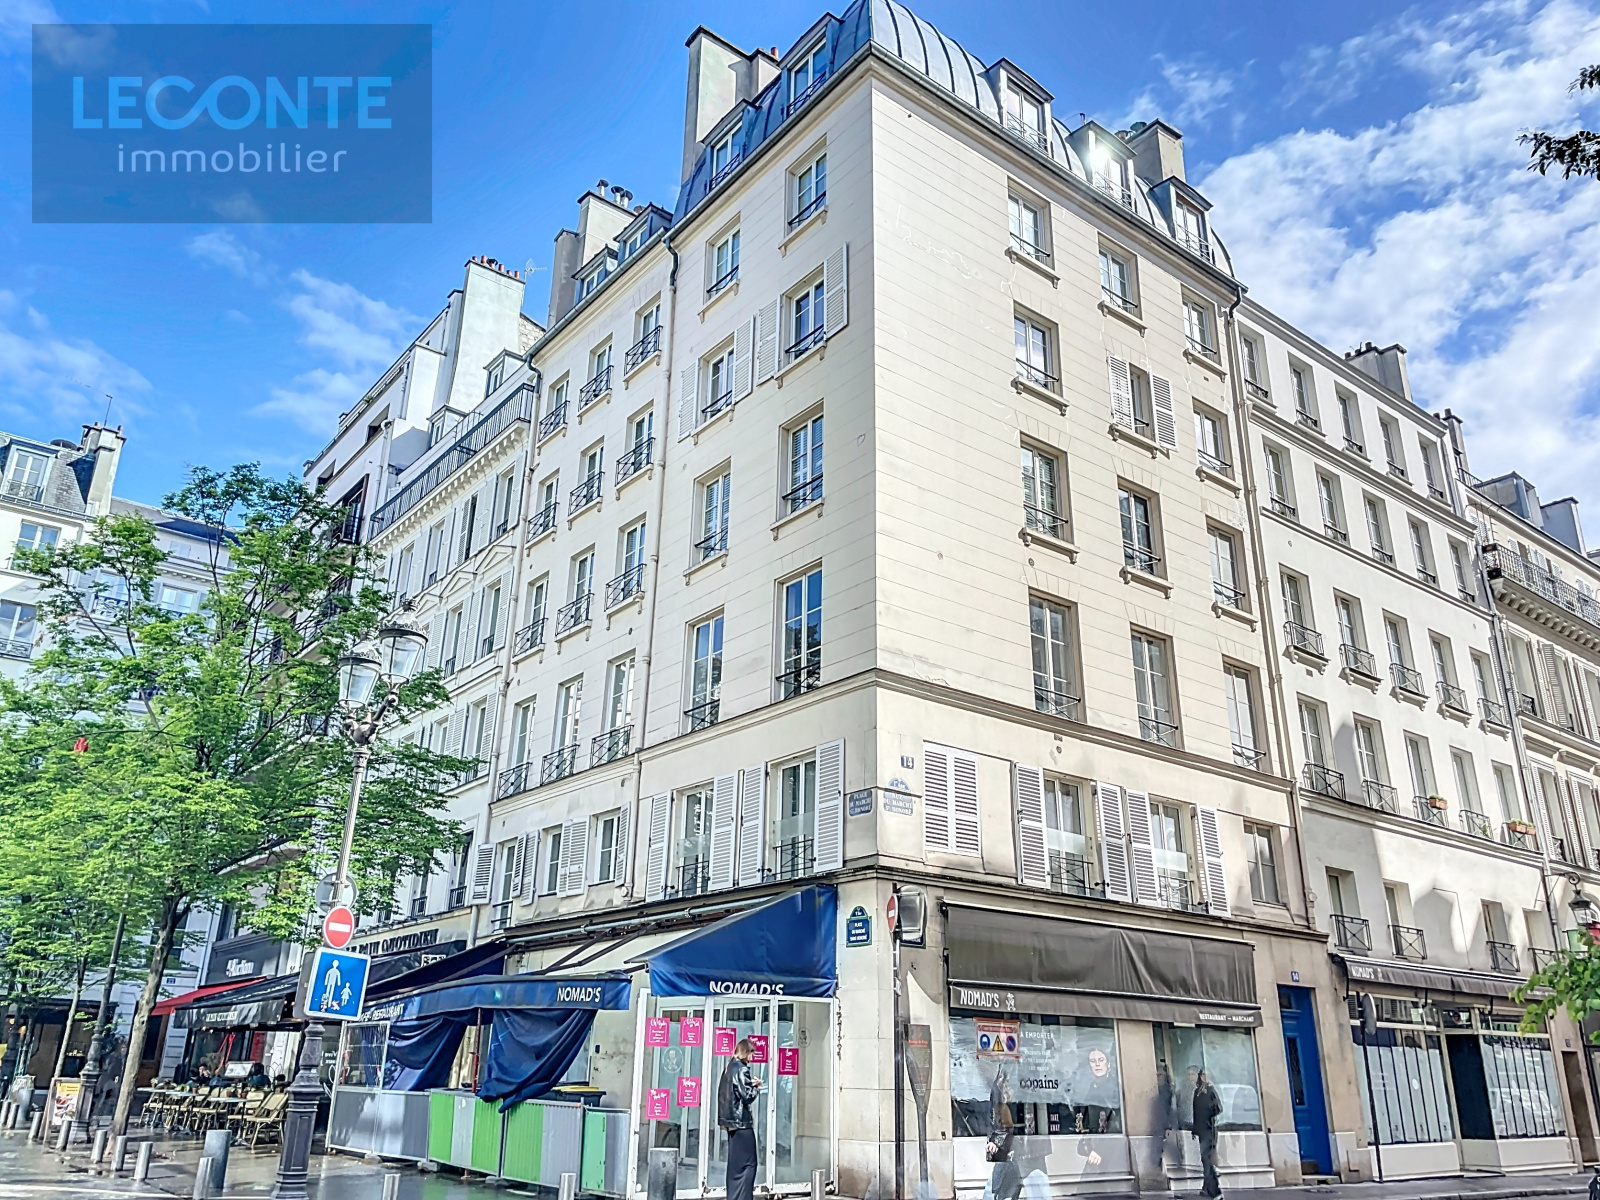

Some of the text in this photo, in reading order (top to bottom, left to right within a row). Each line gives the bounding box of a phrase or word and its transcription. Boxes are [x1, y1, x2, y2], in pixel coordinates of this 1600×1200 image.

[903, 756, 913, 768] 14
[557, 987, 601, 1002] NOMAD'S
[709, 980, 784, 996] NOMAD'S
[960, 989, 1000, 1008] NOMAD'S
[1020, 1075, 1059, 1090] copains
